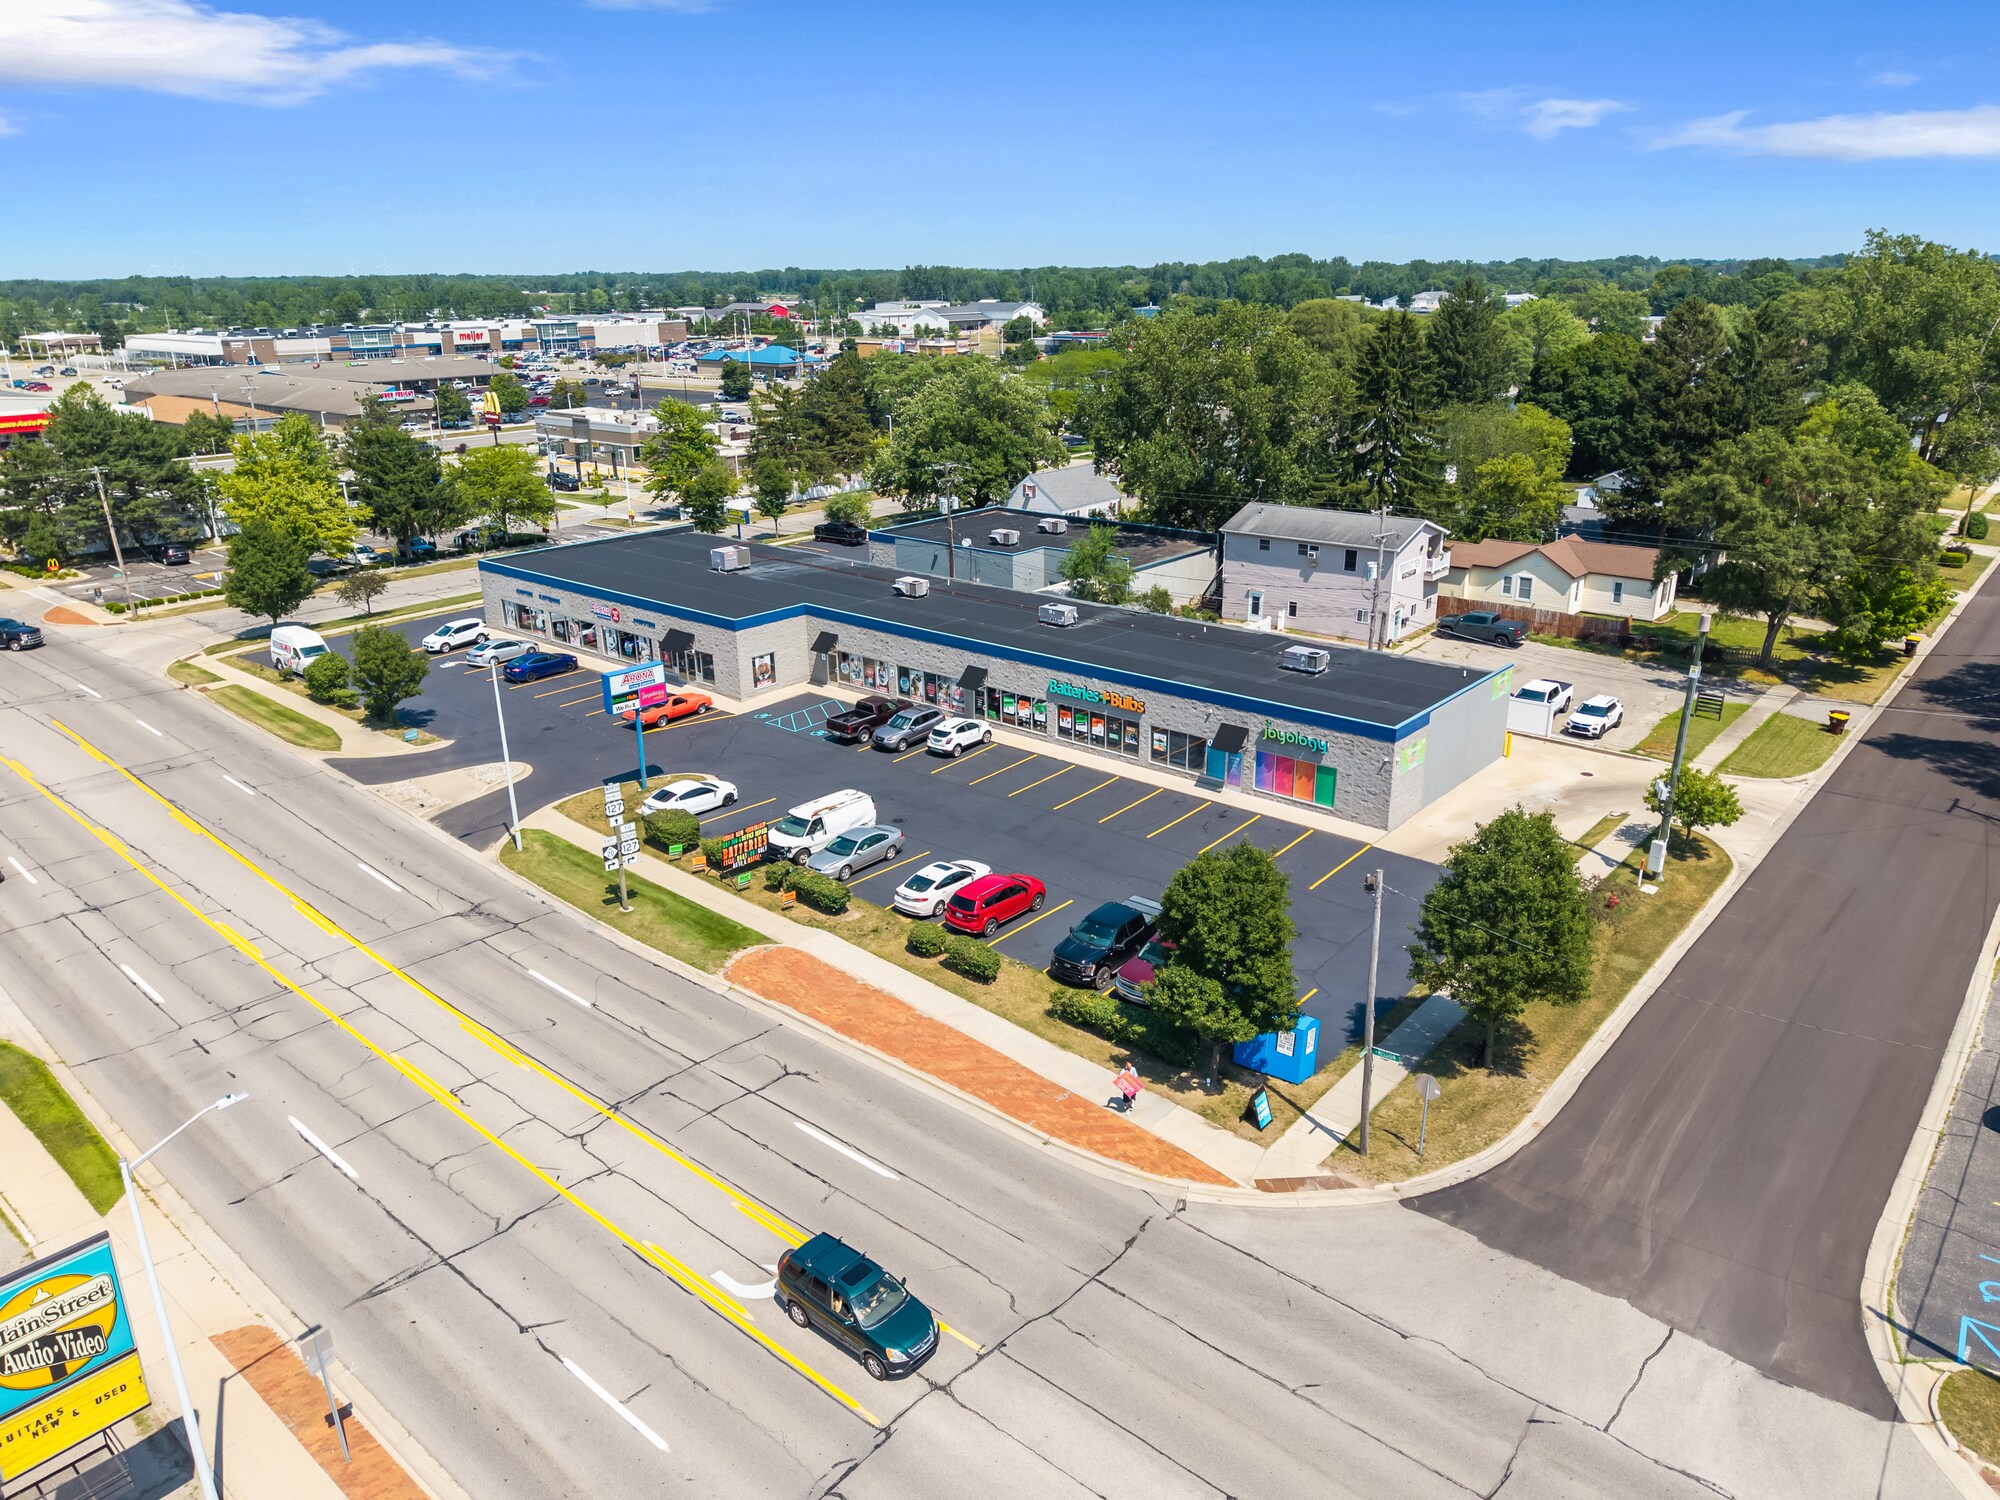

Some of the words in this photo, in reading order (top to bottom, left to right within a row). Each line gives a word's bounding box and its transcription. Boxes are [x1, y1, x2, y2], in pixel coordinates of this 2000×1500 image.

[459, 331, 483, 342] meijer
[621, 669, 654, 686] ARONA
[1109, 692, 1146, 714] Bulbs
[1263, 720, 1329, 754] joyology
[607, 803, 621, 814] 127
[607, 850, 615, 858] 20
[623, 841, 637, 853] 127
[722, 833, 768, 860] BATTERIES
[43, 1283, 109, 1324] Street
[3, 1340, 54, 1375] Audio
[56, 1331, 104, 1360] Video
[31, 1418, 60, 1439] NEW
[72, 1409, 79, 1417] &
[95, 1384, 127, 1405] USED
